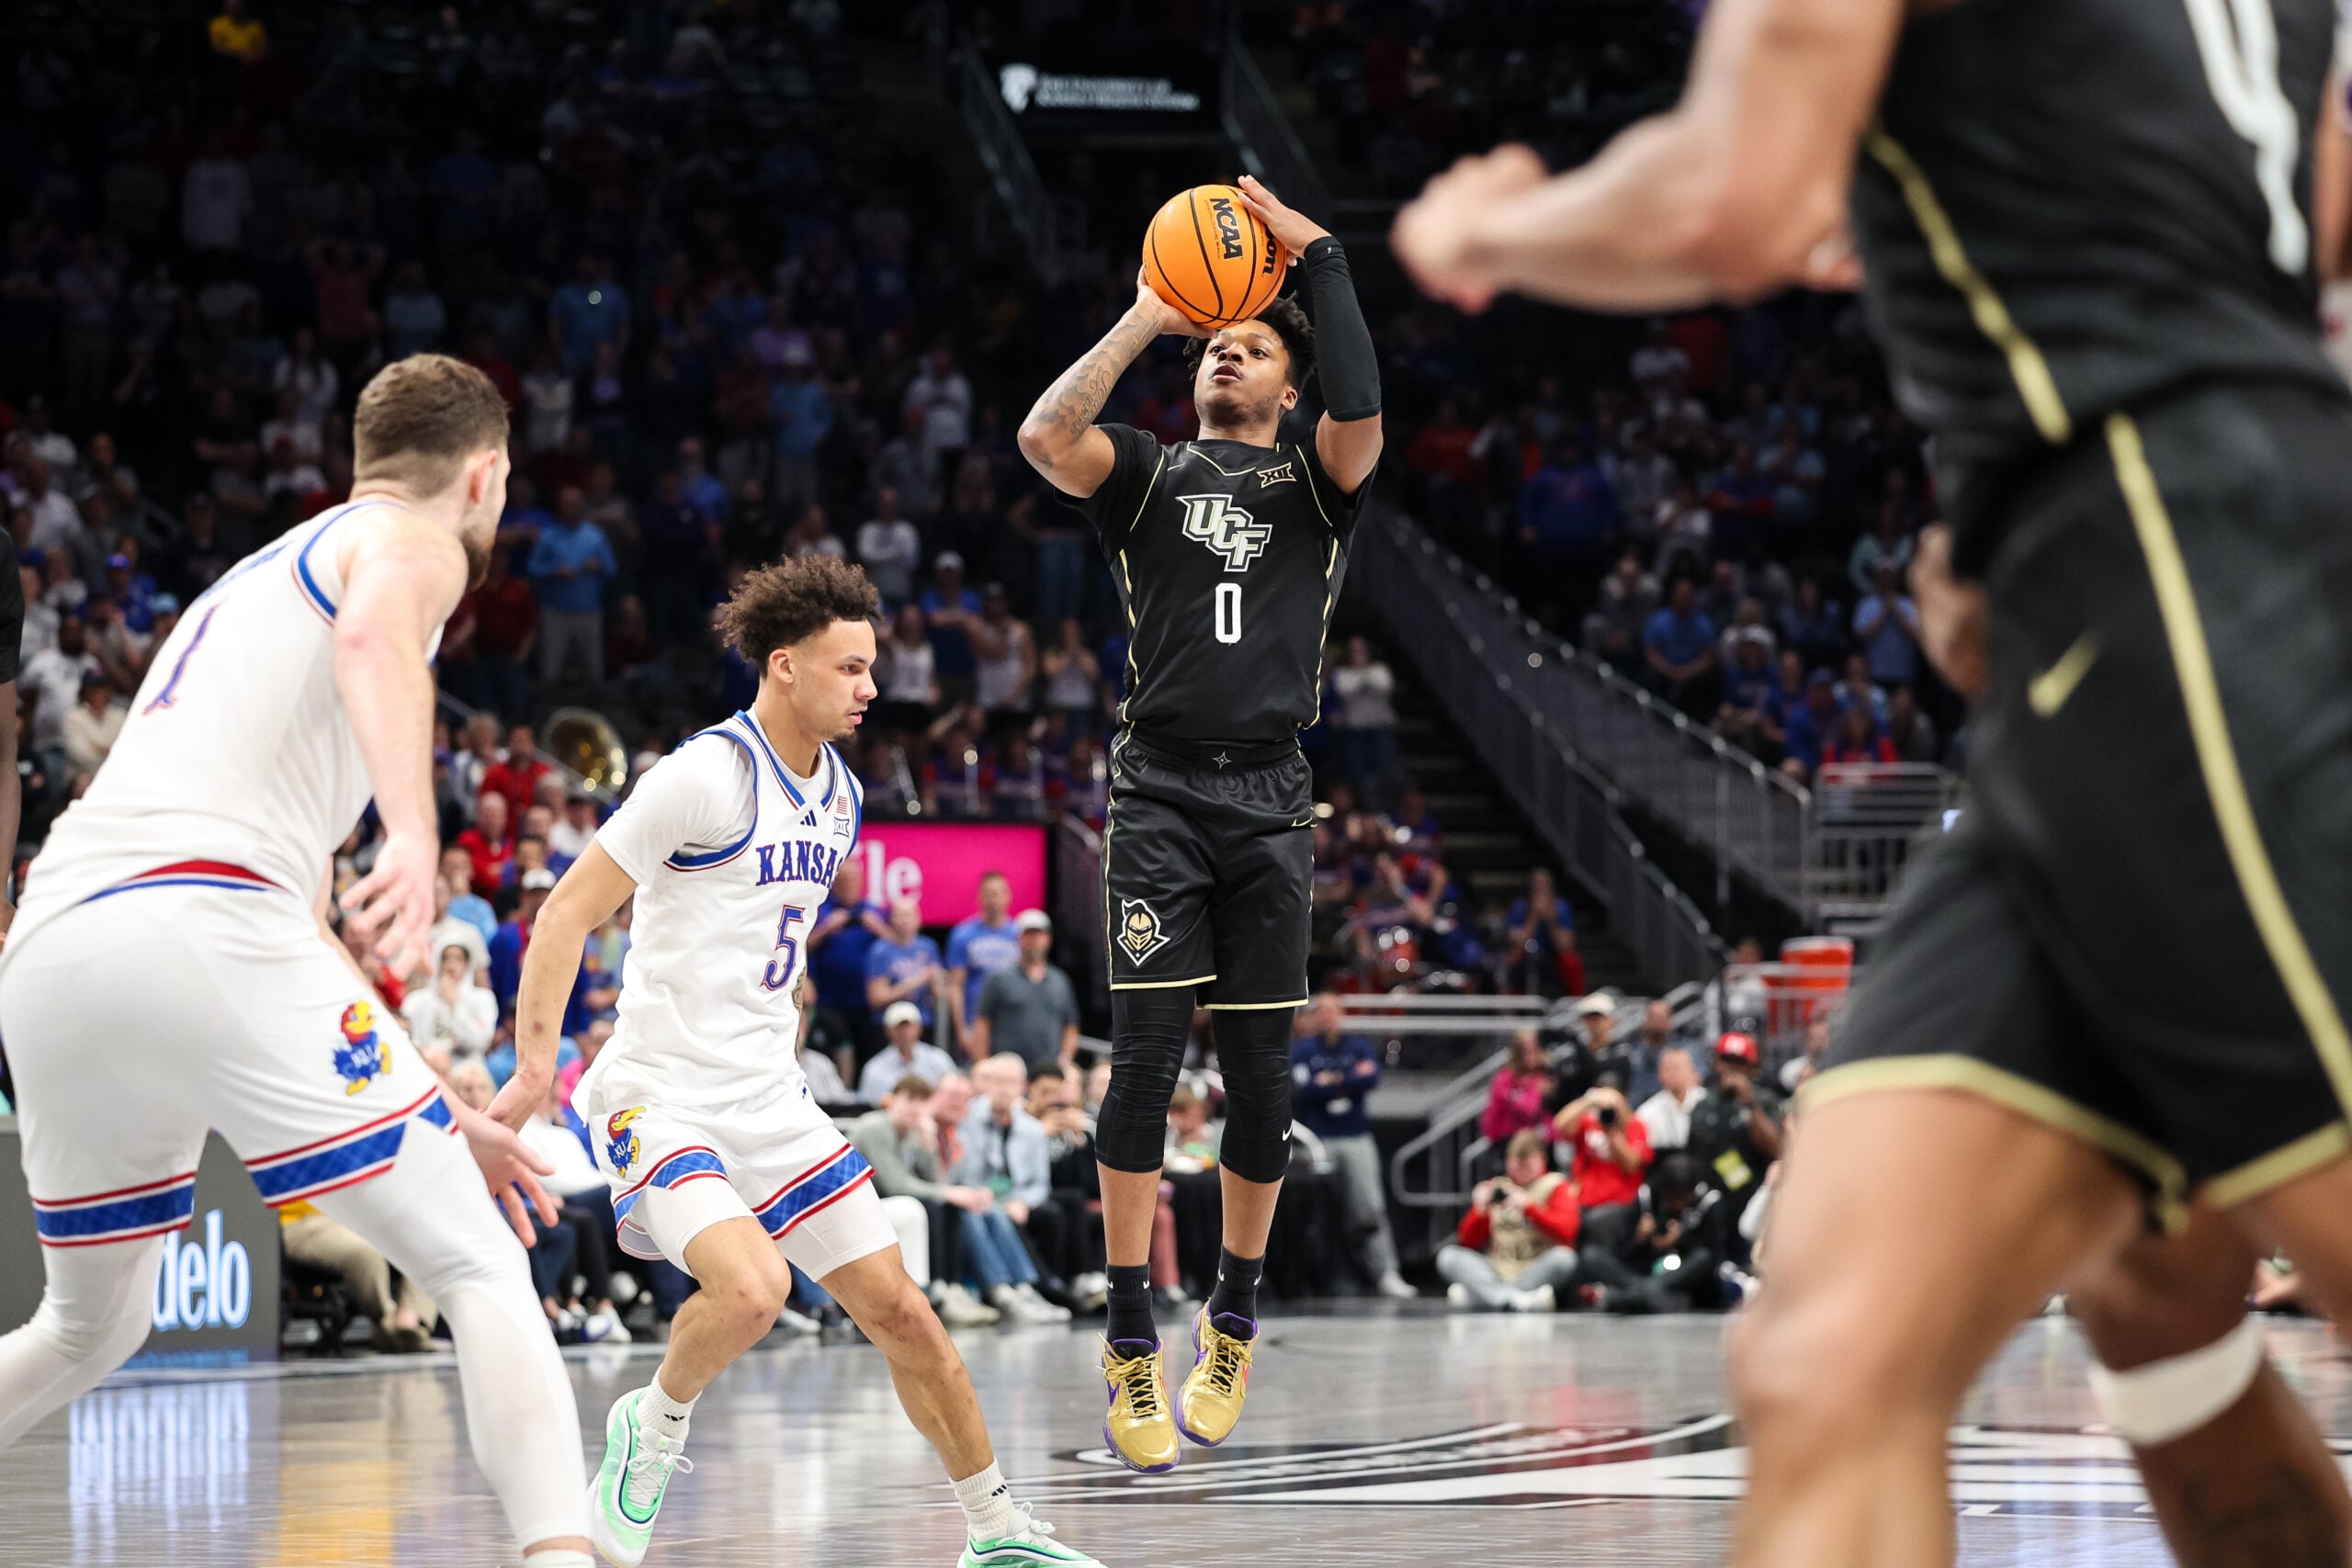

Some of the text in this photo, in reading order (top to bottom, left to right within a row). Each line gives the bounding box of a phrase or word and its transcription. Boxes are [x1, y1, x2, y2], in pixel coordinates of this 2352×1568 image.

[1210, 198, 1243, 260] NCAA
[1177, 494, 1272, 571] UCF
[1215, 582, 1242, 644] 0
[142, 599, 226, 716] 1
[760, 905, 806, 991] 5
[614, 1141, 627, 1158] KU
[153, 1209, 252, 1332] delo
